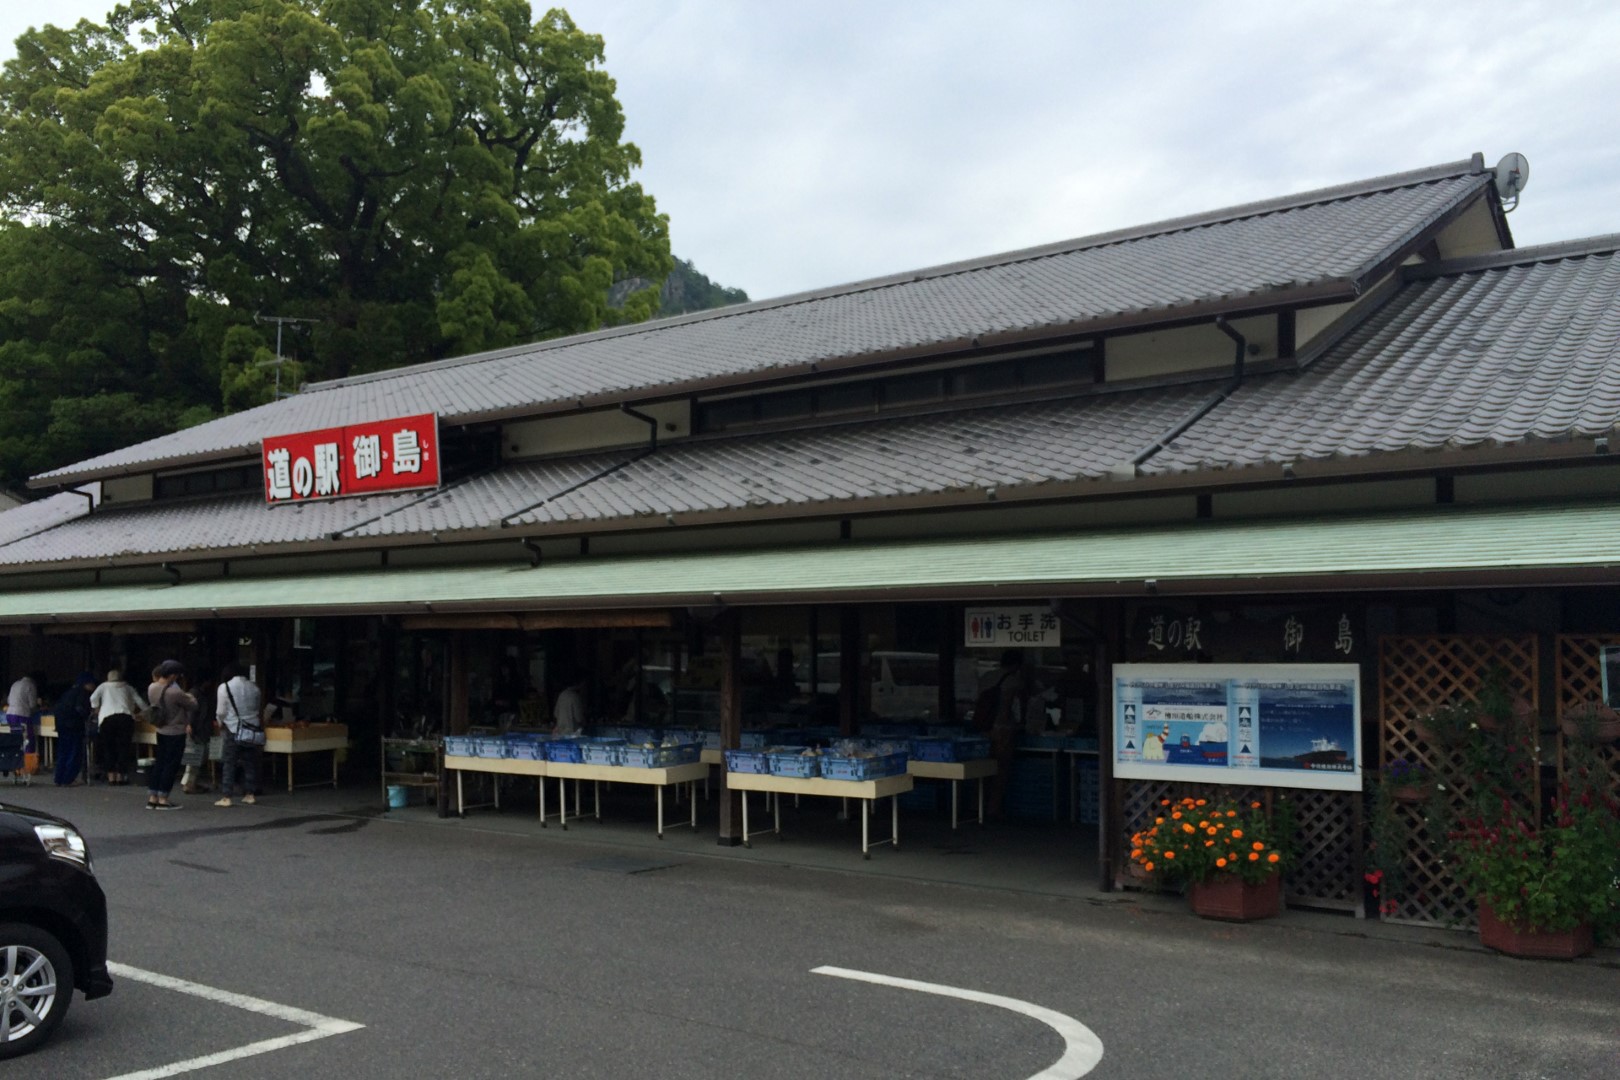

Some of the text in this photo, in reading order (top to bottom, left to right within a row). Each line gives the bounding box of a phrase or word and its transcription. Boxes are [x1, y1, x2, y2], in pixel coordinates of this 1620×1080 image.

[268, 442, 340, 499] 道の駅
[997, 613, 1057, 630] お手洗
[1147, 616, 1202, 651] 道の駅
[1007, 631, 1046, 643] TOILET
